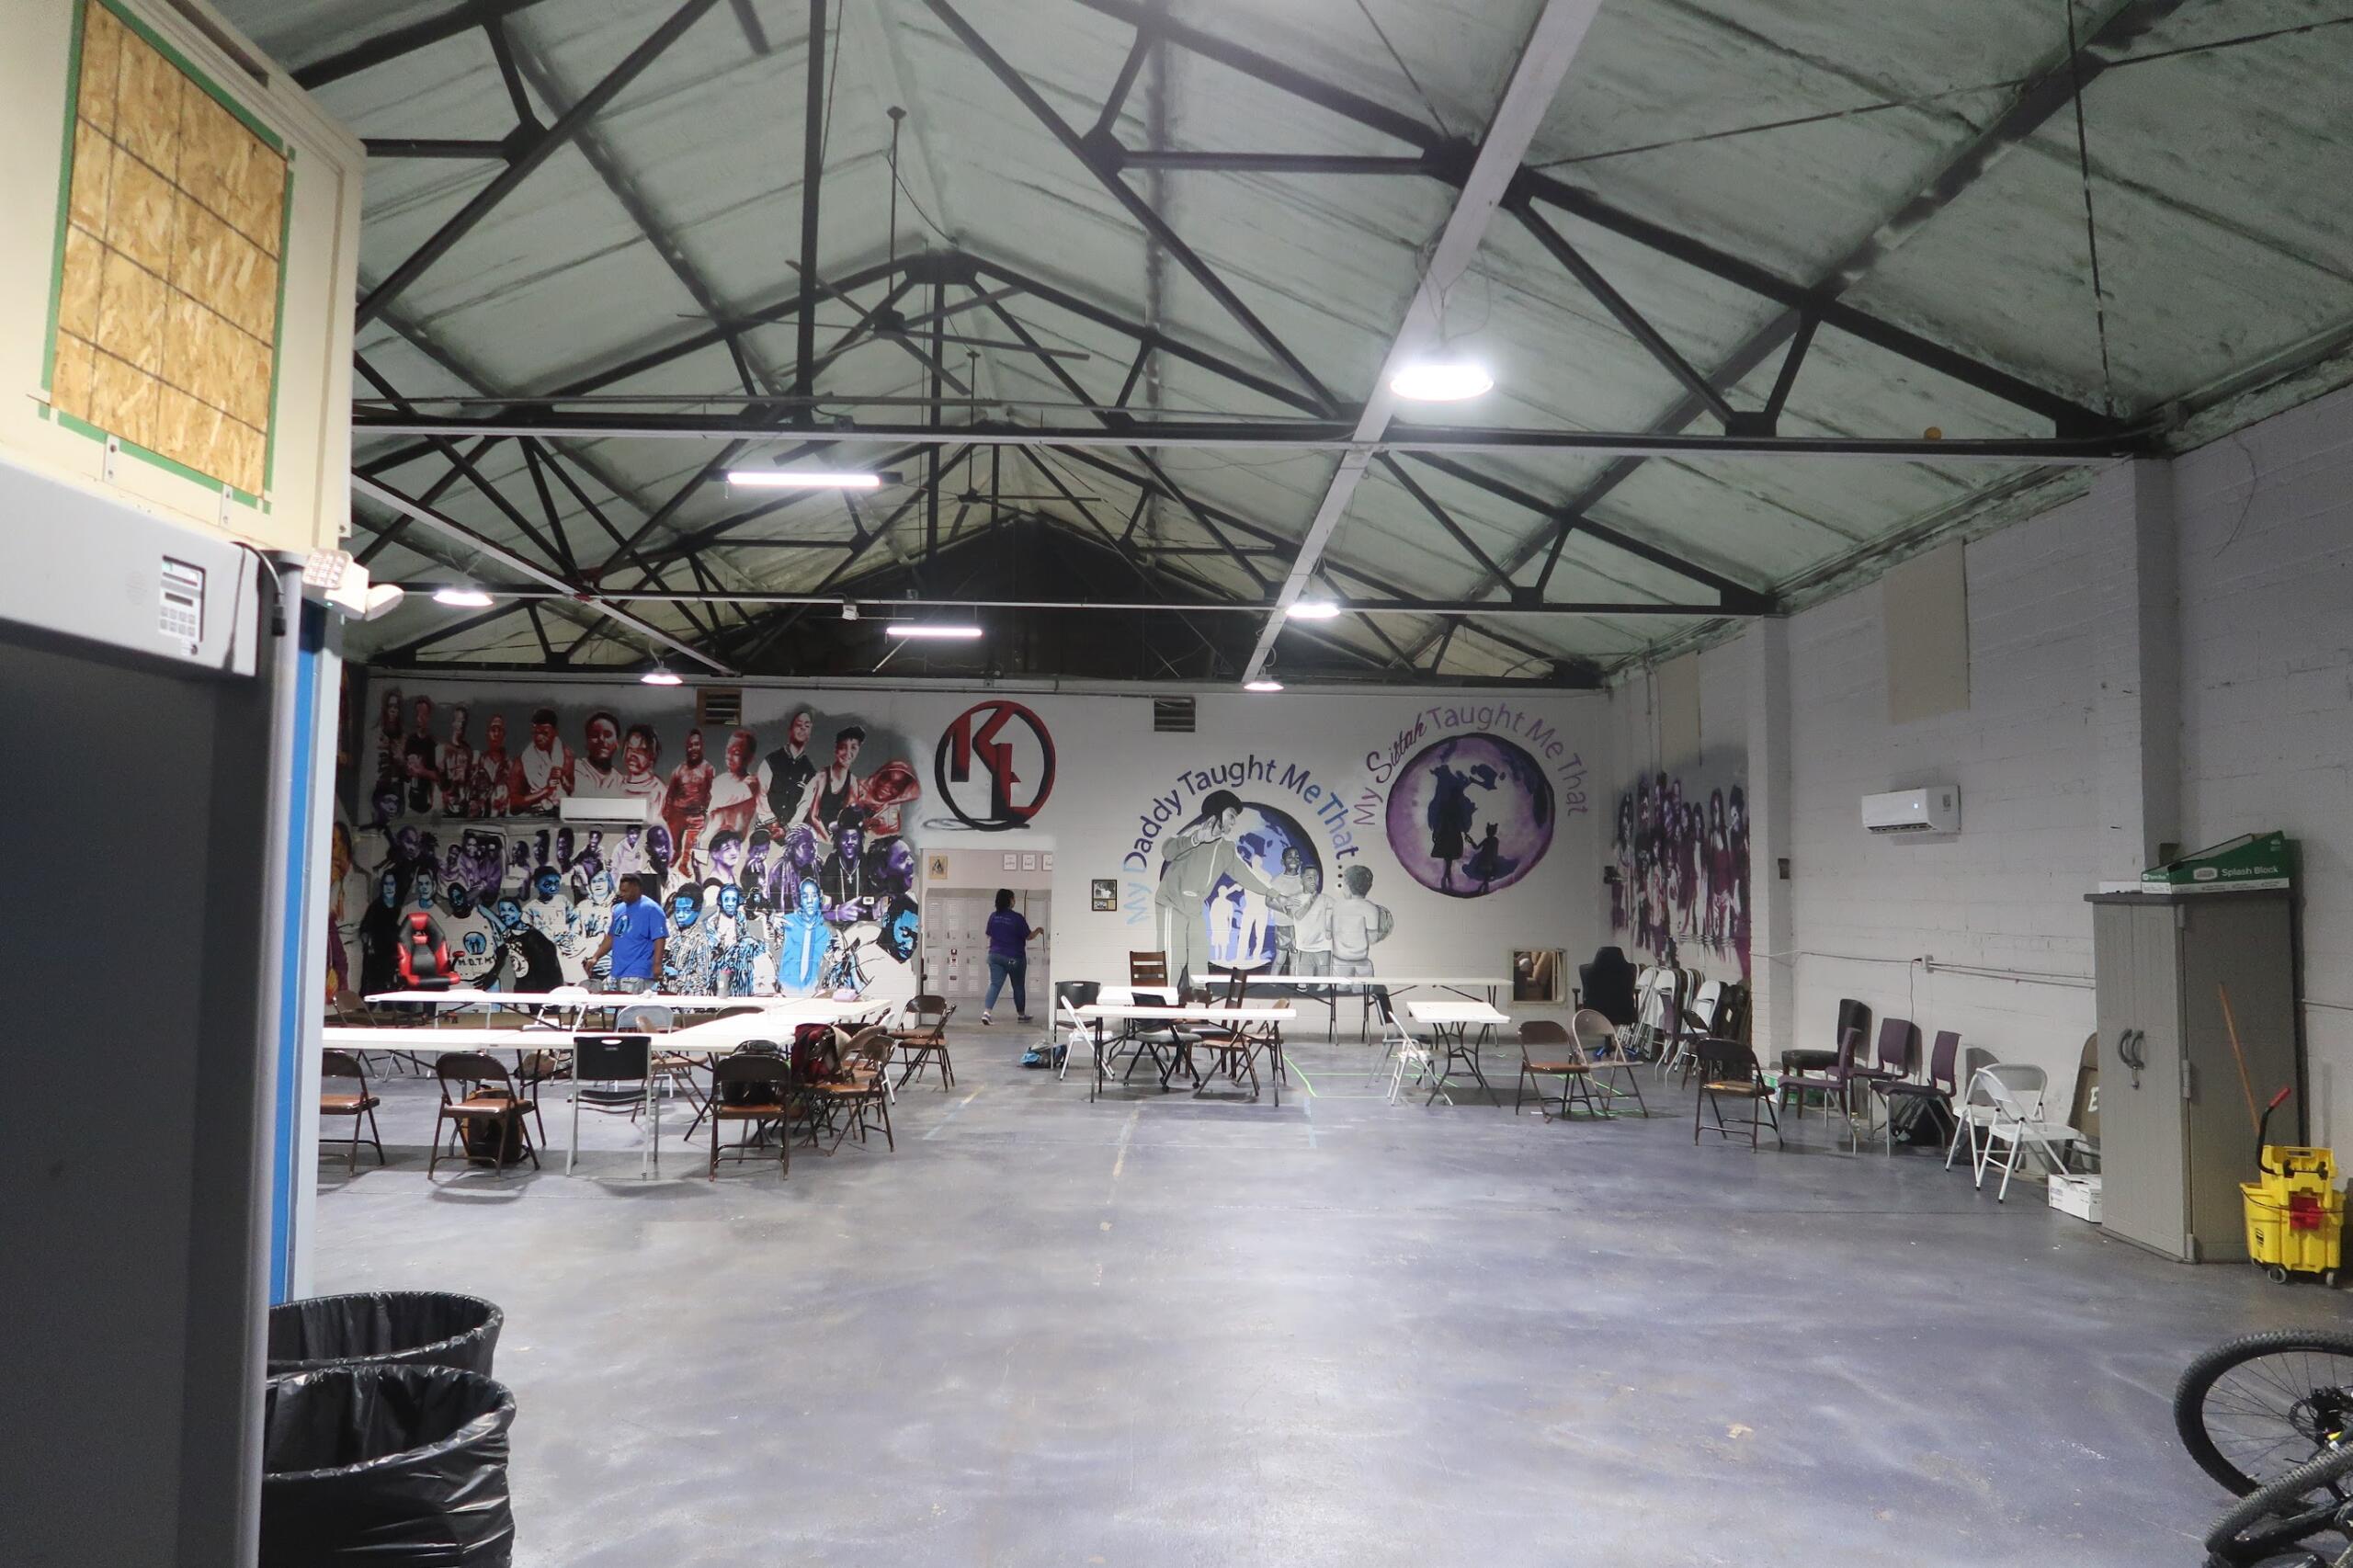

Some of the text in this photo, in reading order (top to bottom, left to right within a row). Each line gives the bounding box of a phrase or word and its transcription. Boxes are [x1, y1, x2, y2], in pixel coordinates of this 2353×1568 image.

[1176, 755, 1277, 796] Taught
[1279, 763, 1321, 804] Me
[1353, 702, 1589, 825] My Sistah Taught Me That
[1122, 789, 1182, 872] Daddy
[2221, 867, 2252, 877] Splash
[2254, 865, 2279, 874] Block
[1123, 881, 1152, 925] My
